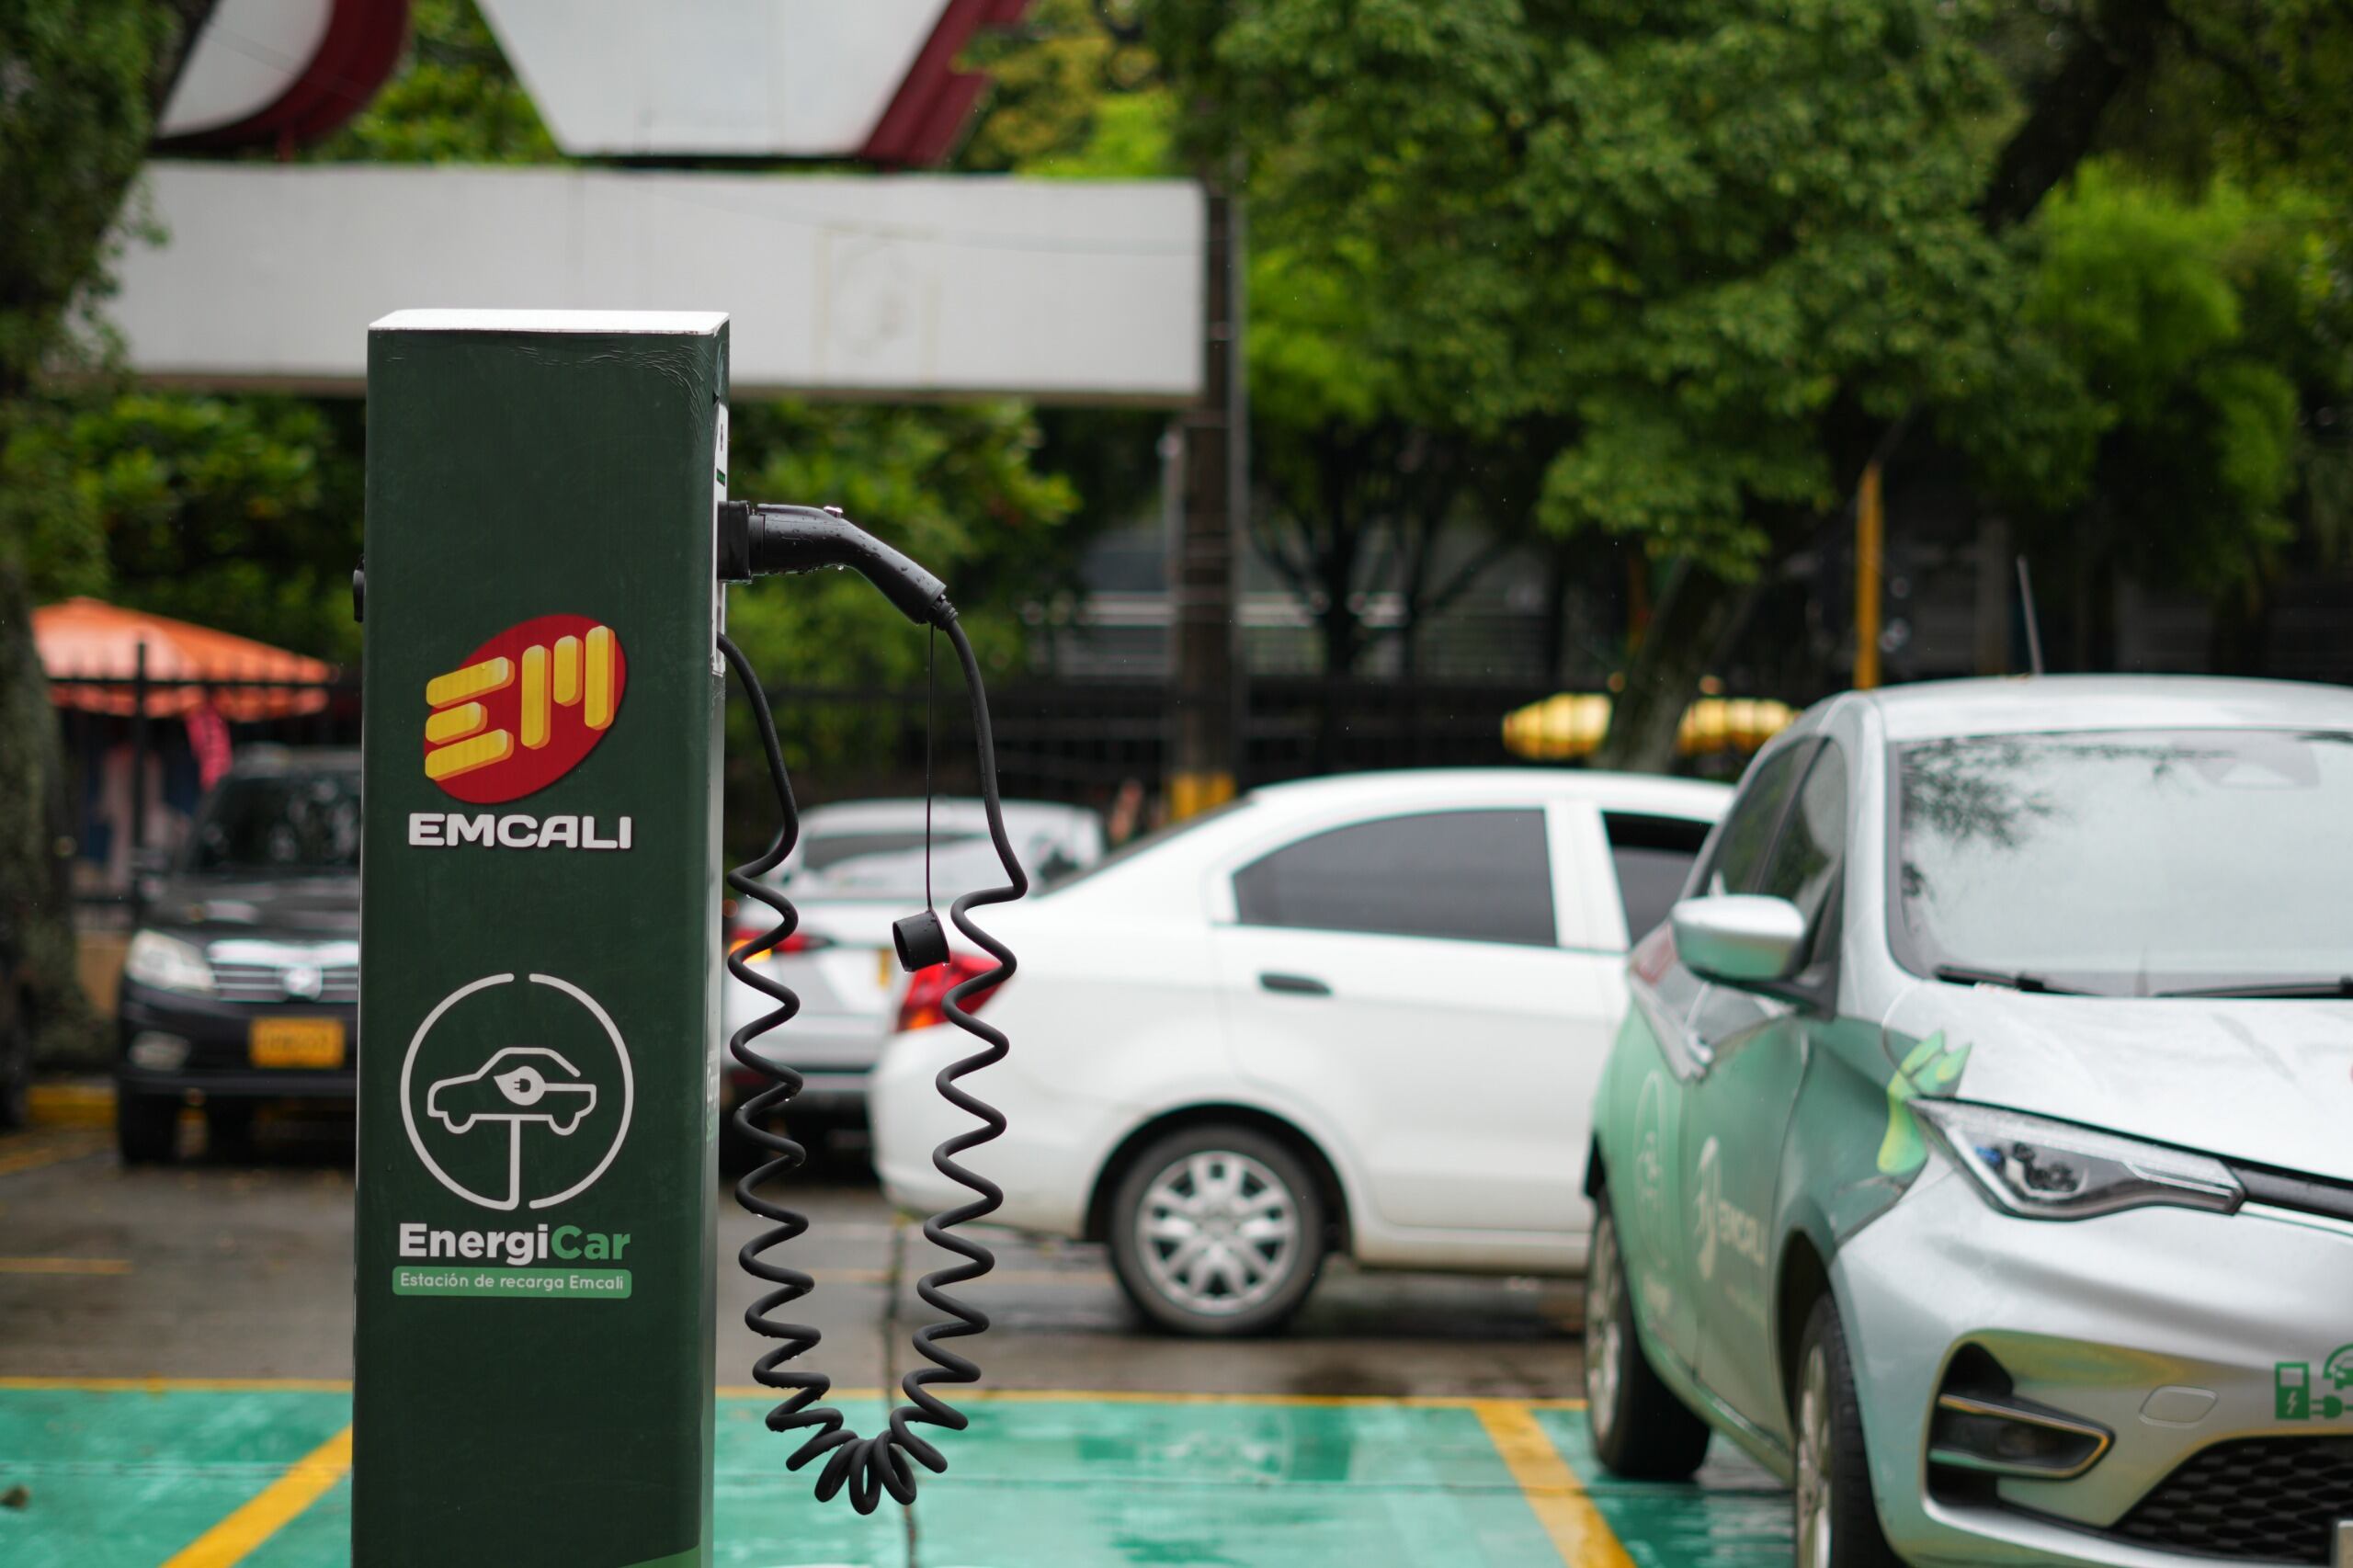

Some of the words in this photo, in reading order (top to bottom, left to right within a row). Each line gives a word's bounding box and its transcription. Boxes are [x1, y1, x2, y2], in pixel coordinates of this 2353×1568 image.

[408, 812, 632, 849] EMCALI
[399, 1222, 631, 1267] EnergiCar
[400, 1272, 469, 1288] Estación
[474, 1274, 494, 1288] de
[500, 1278, 564, 1292] recarga
[569, 1275, 624, 1290] Emcali
